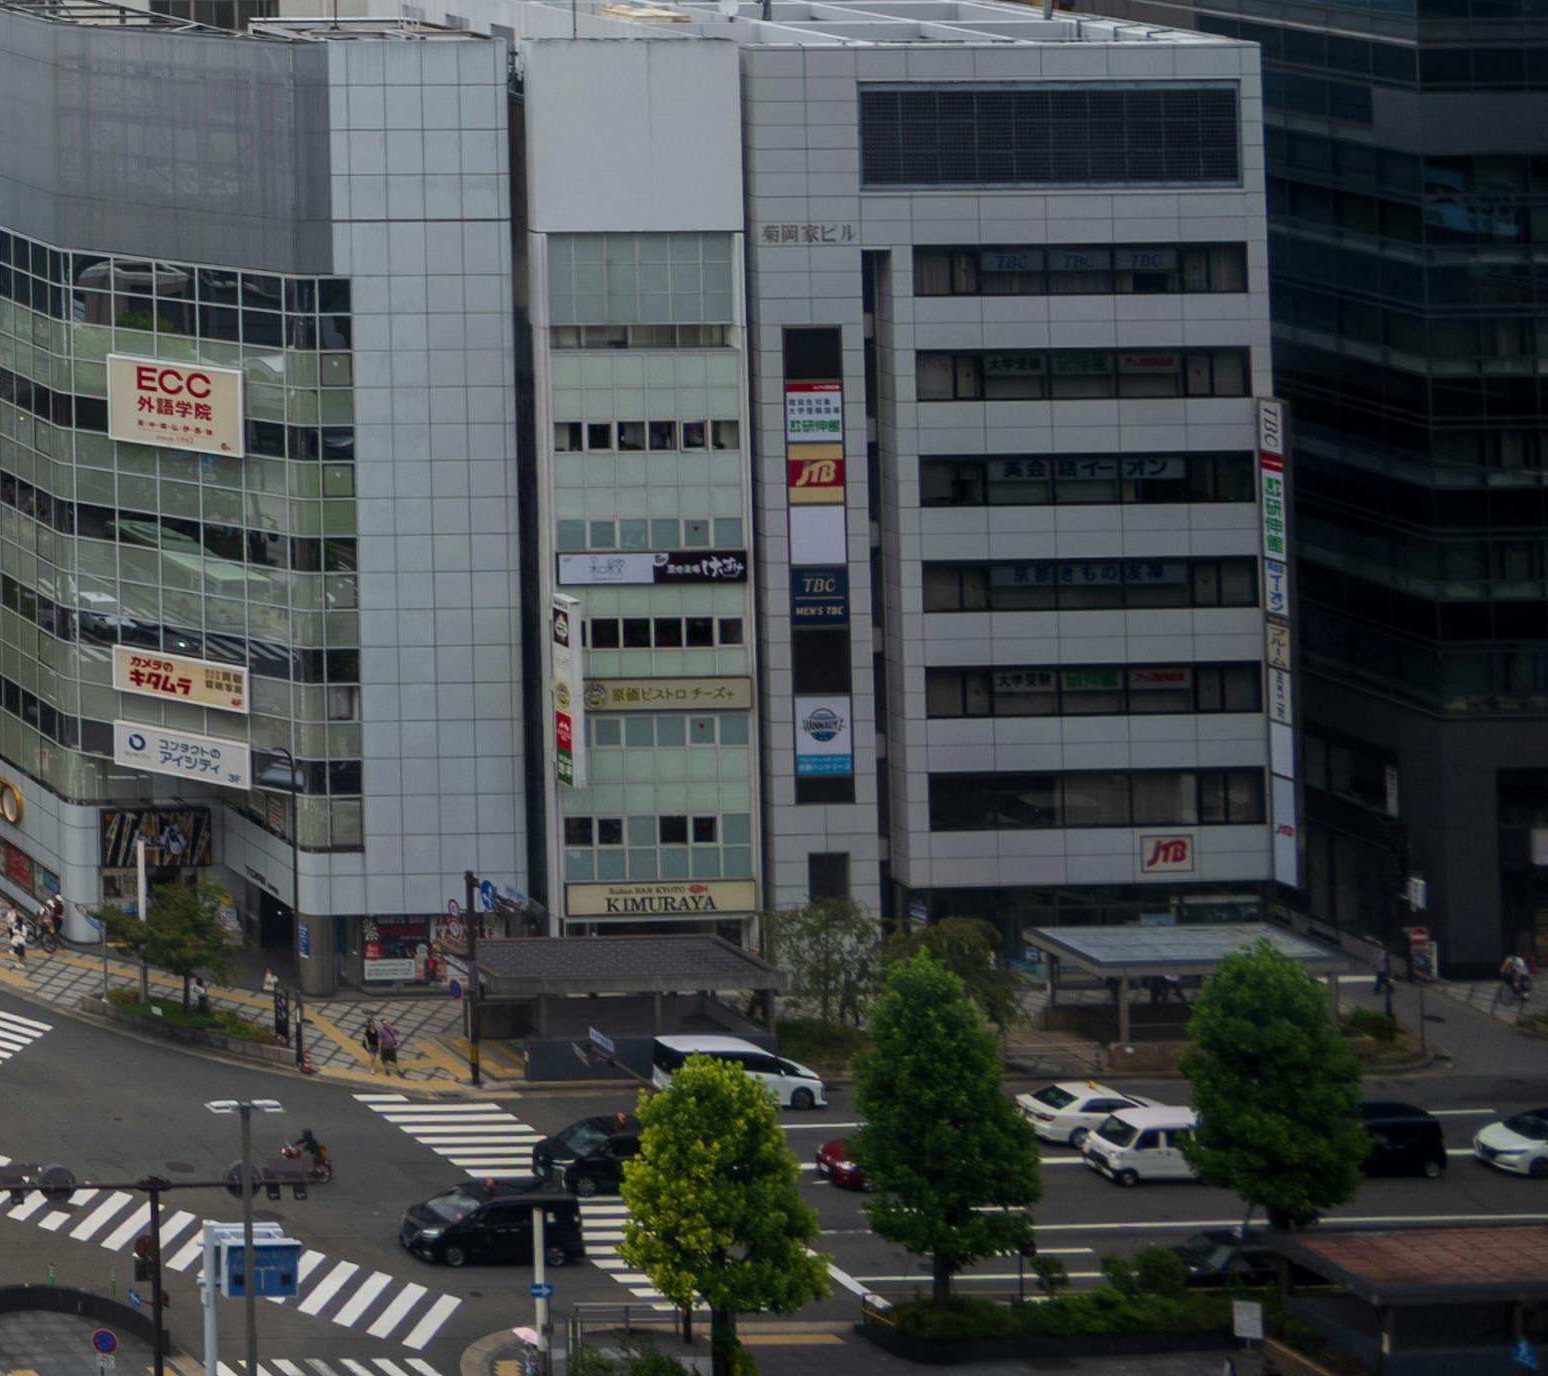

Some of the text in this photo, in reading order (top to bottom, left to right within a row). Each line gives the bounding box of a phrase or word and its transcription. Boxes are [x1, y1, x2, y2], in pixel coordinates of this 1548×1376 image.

[762, 224, 856, 243] 菊岡家ビル
[996, 255, 1028, 268] TBC
[1063, 254, 1096, 268] TBC
[1132, 254, 1162, 268] TBC
[136, 366, 211, 399] ECC
[137, 396, 212, 421] 外語学院
[795, 459, 837, 487] JTB
[803, 576, 836, 593] TBC
[130, 656, 174, 673] カメラの
[129, 669, 192, 696] キタムラ
[159, 739, 221, 759] コンタクトの
[159, 751, 220, 774] アイシティ
[1147, 839, 1187, 867] JTB
[606, 896, 717, 914] KIMURAYA
